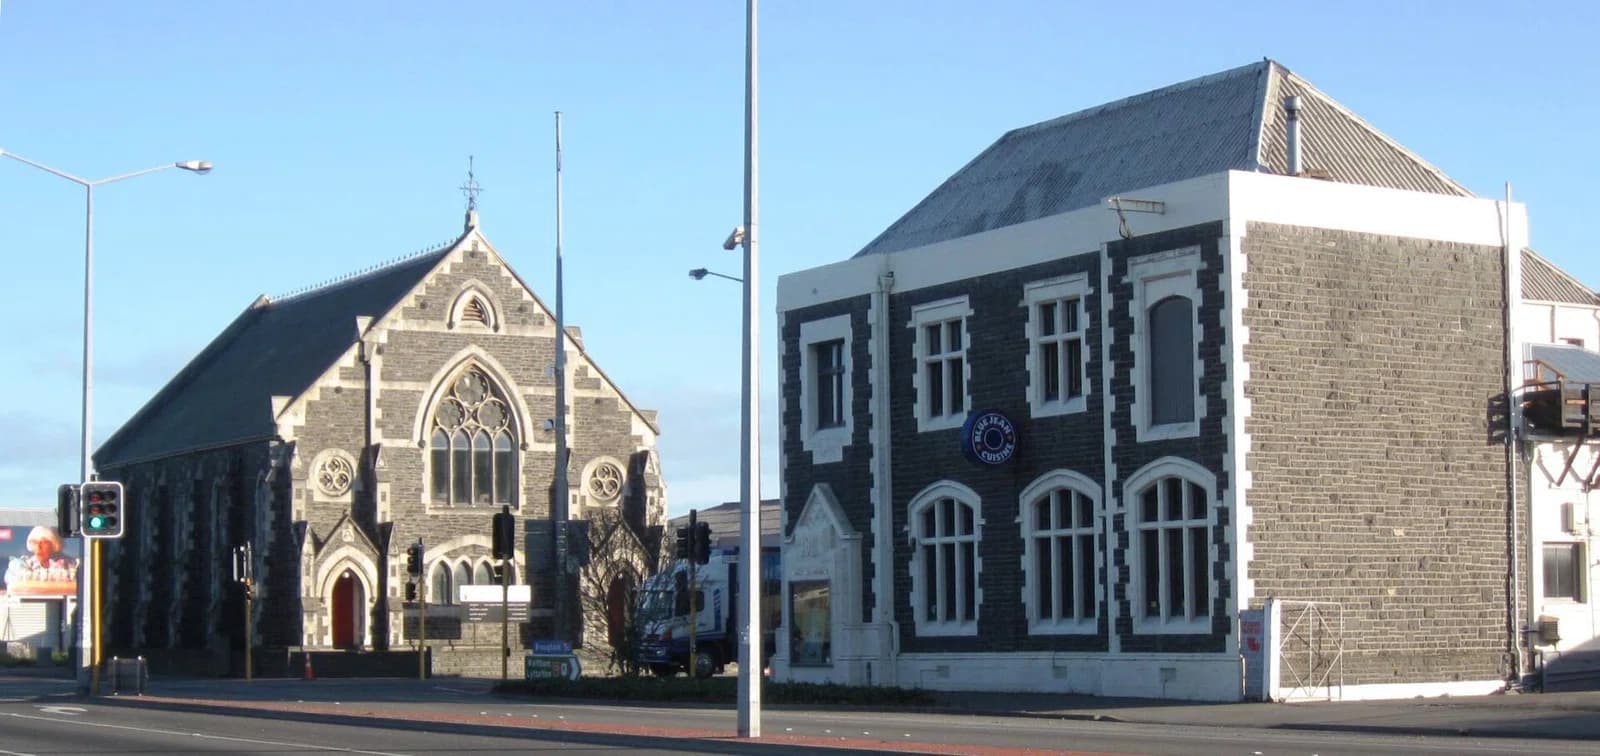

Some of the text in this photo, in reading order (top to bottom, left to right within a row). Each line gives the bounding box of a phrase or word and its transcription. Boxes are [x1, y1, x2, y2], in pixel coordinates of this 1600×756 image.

[974, 416, 1011, 442] BLUE JEAN
[981, 443, 1014, 461] CUISINE
